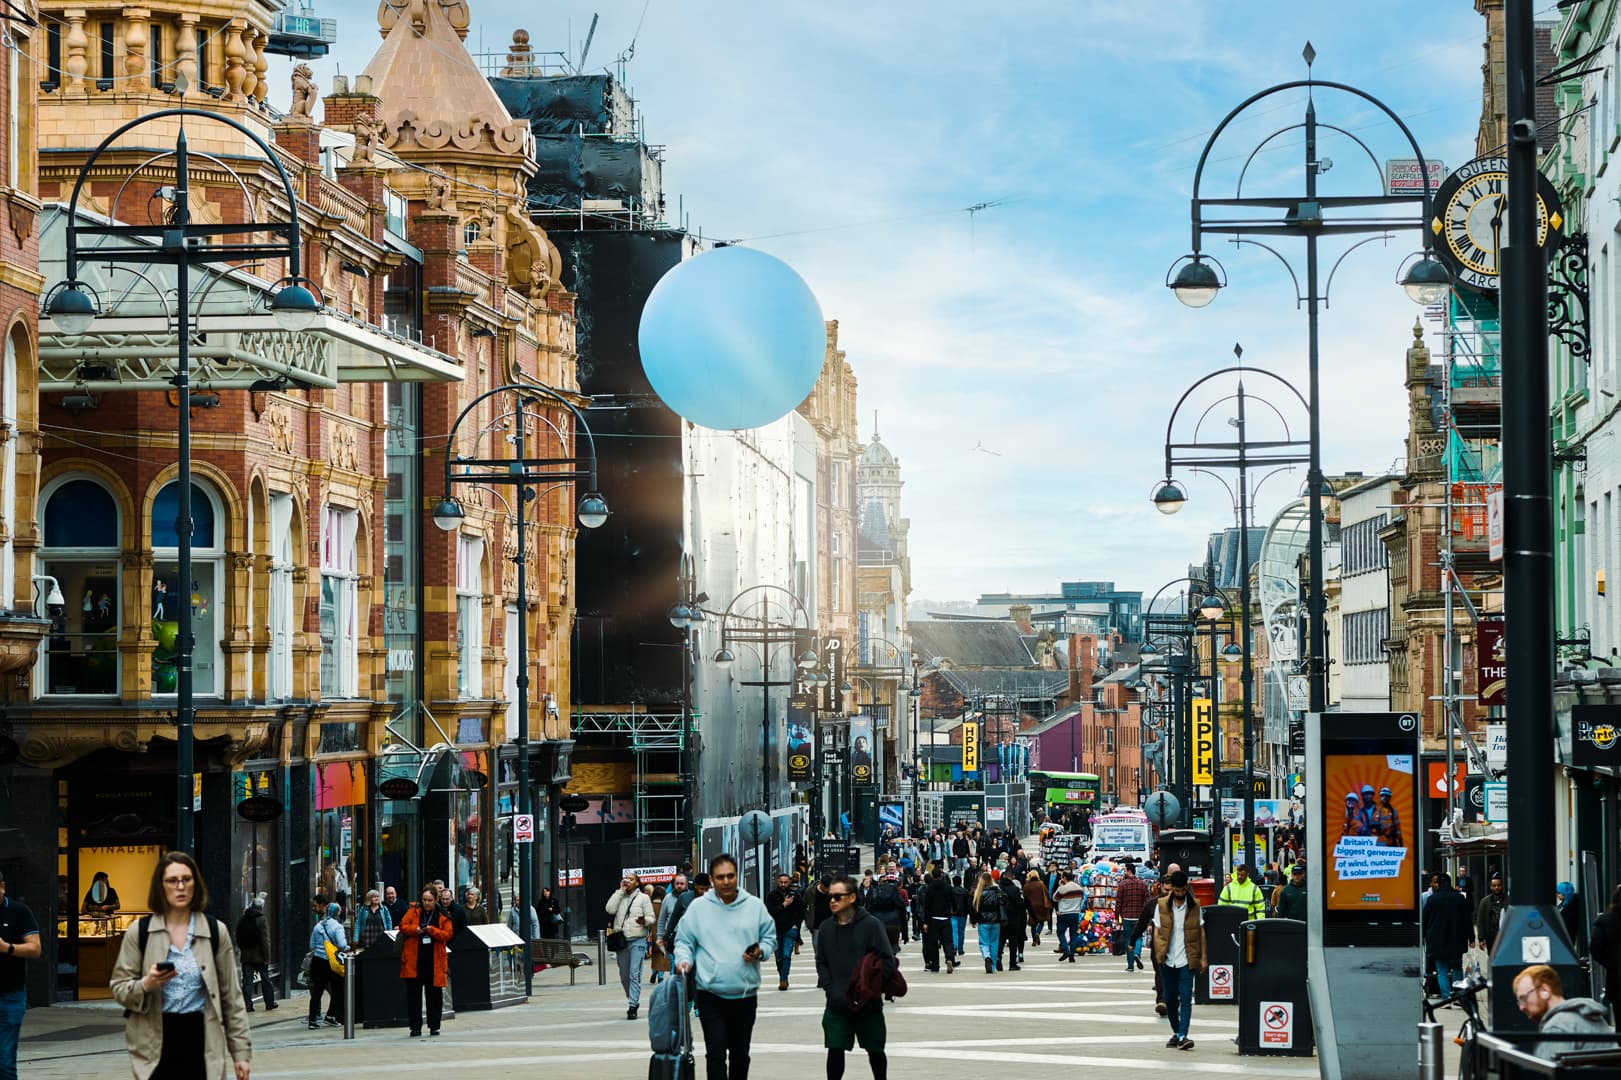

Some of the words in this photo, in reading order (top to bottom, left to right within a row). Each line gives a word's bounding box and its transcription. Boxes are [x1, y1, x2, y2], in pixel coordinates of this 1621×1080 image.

[295, 17, 310, 34] HG
[825, 639, 841, 650] JD
[388, 648, 414, 671] NICHOLS
[1402, 719, 1412, 727] BT
[1196, 705, 1212, 775] HPPH
[965, 726, 975, 766] HPPH
[1343, 838, 1374, 846] Britain's
[1336, 847, 1366, 857] biggest
[1366, 848, 1405, 857] generator
[1370, 859, 1398, 867] nuclear
[642, 867, 665, 875] PARKING
[1342, 869, 1349, 877] &
[1350, 868, 1369, 876] solar
[1369, 867, 1397, 877] energy
